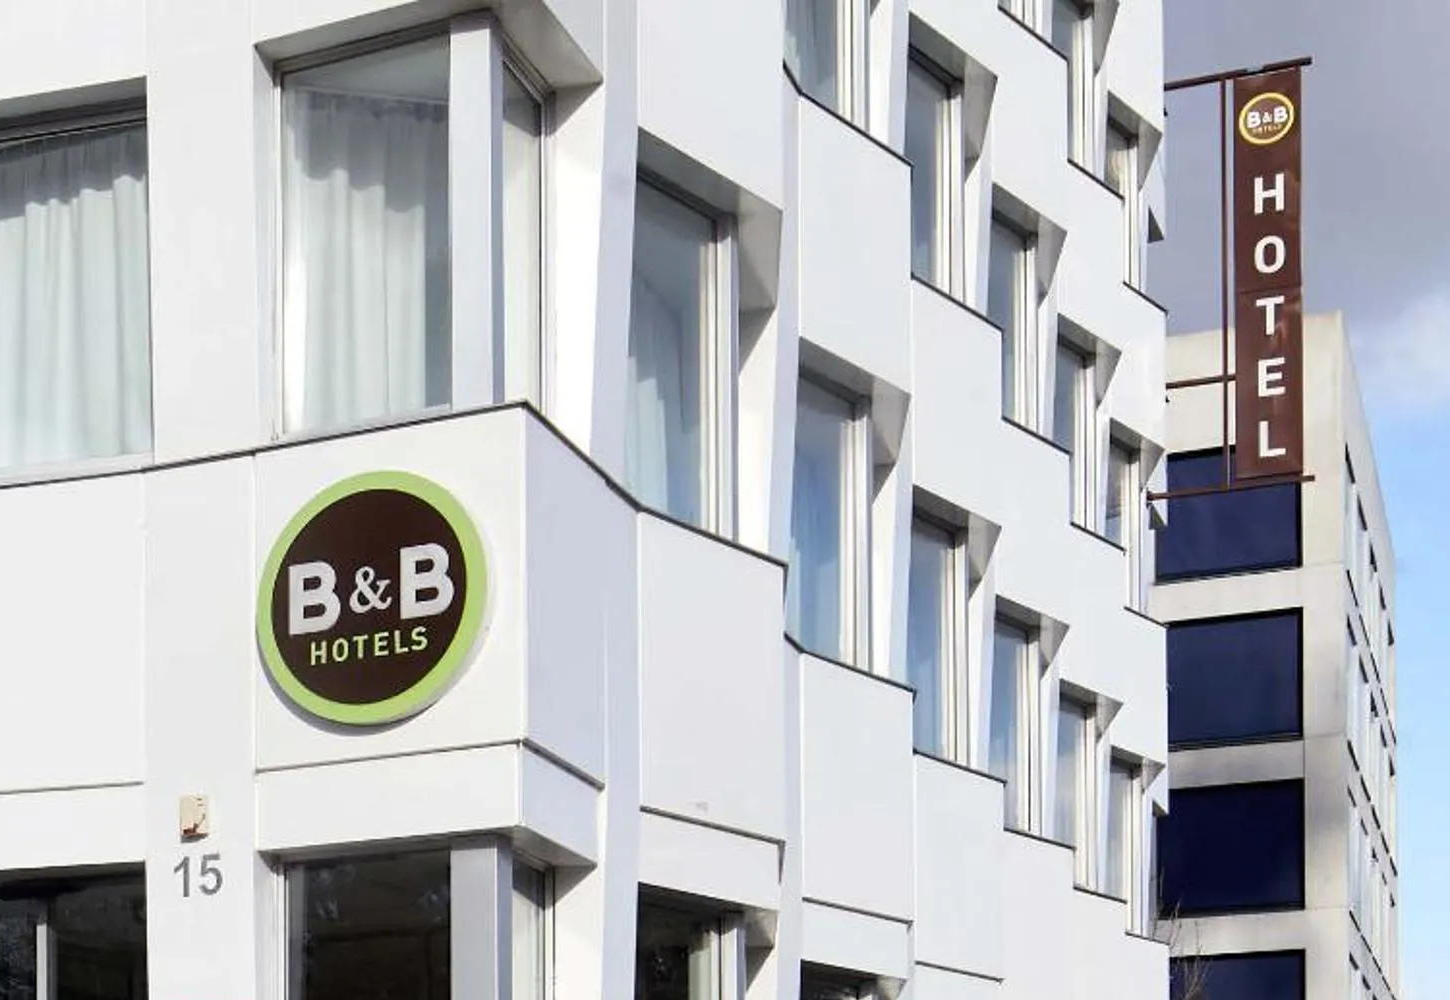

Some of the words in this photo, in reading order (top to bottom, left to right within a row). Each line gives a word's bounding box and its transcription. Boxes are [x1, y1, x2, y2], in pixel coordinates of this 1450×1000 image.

[1246, 106, 1288, 129] B&B
[1253, 172, 1287, 459] HOTEL
[287, 542, 455, 636] B&B
[309, 625, 429, 666] HOTELS
[173, 853, 223, 898] 15
